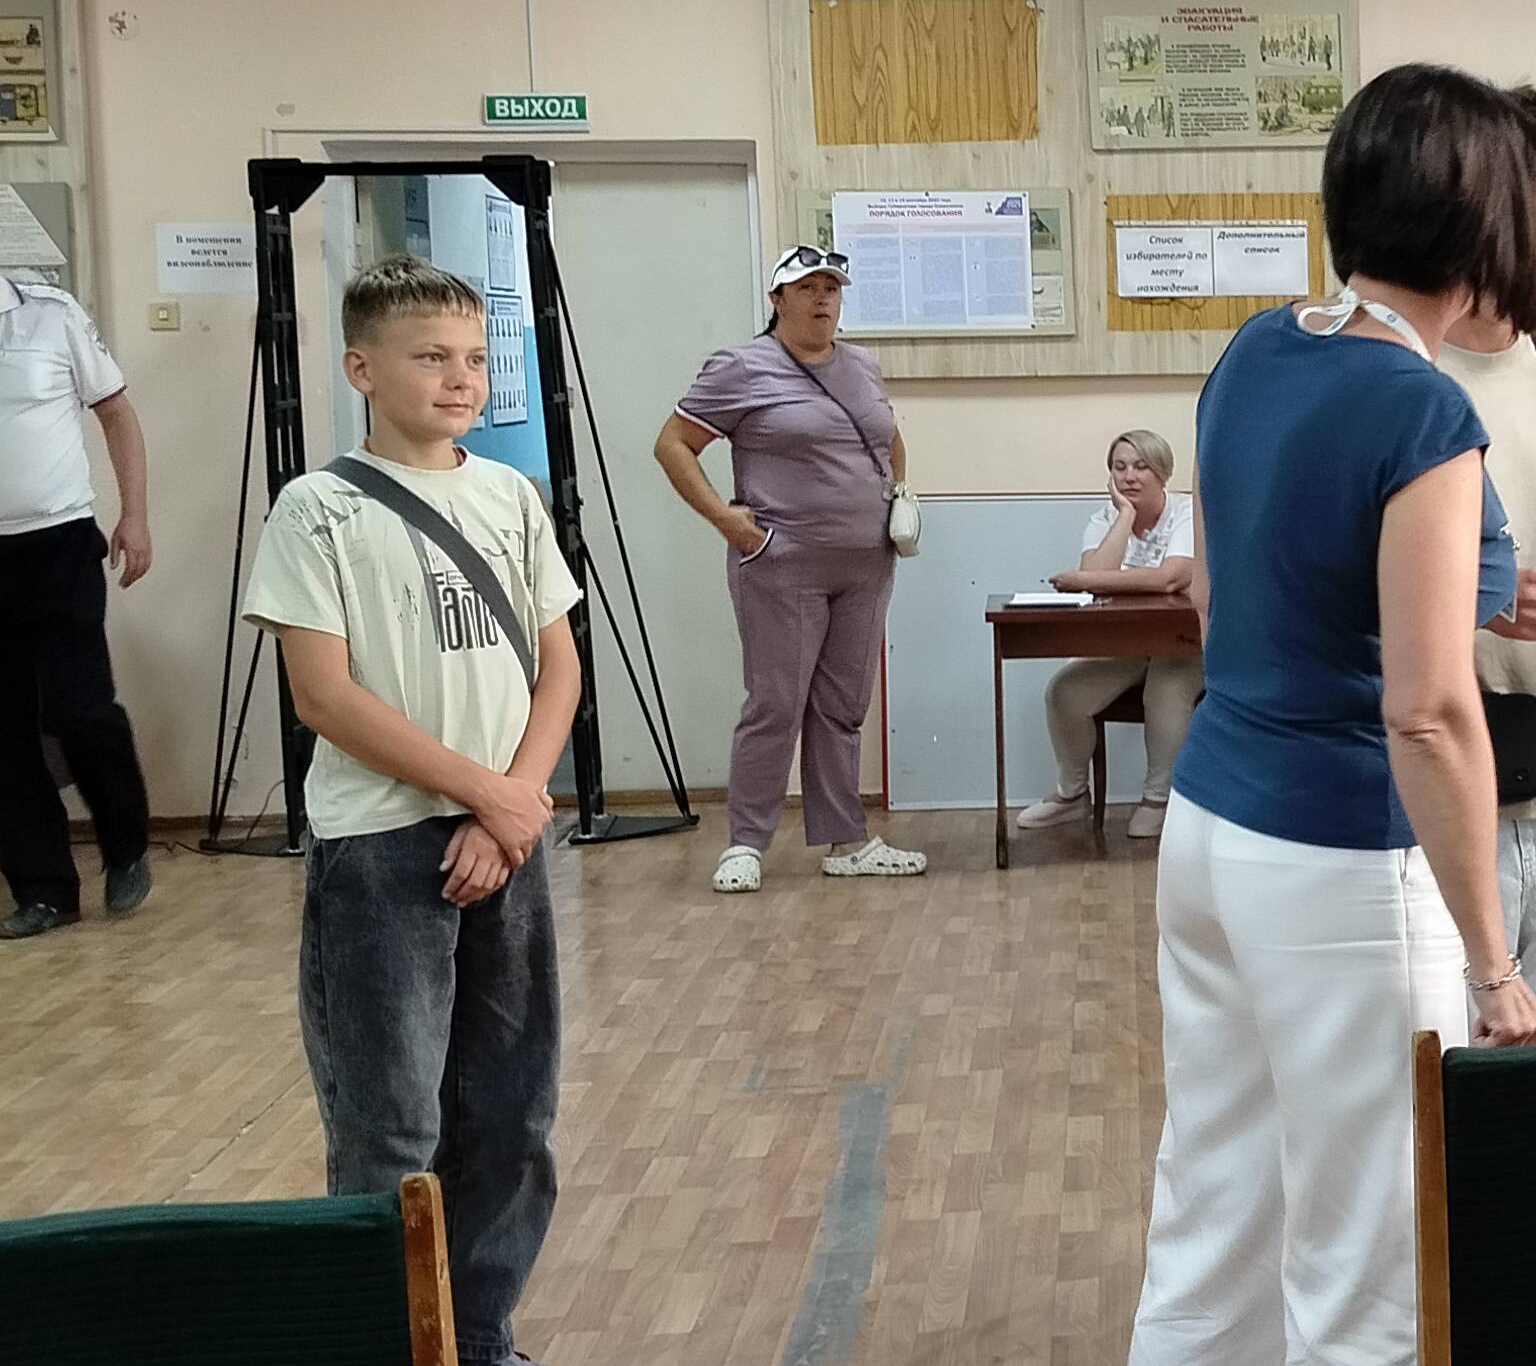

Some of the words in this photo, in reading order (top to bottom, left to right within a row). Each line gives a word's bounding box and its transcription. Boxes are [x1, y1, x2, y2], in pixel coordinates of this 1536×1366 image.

[1187, 24, 1234, 32] РАБОТЫ
[494, 97, 580, 119] ВЫХОД
[1149, 234, 1184, 245] Список
[1217, 231, 1305, 240] Дополнительный
[1244, 246, 1280, 254] список
[1126, 250, 1193, 262] избирателей
[1195, 252, 1208, 261] по
[1150, 268, 1185, 277] месту
[1136, 283, 1199, 293] нахождения
